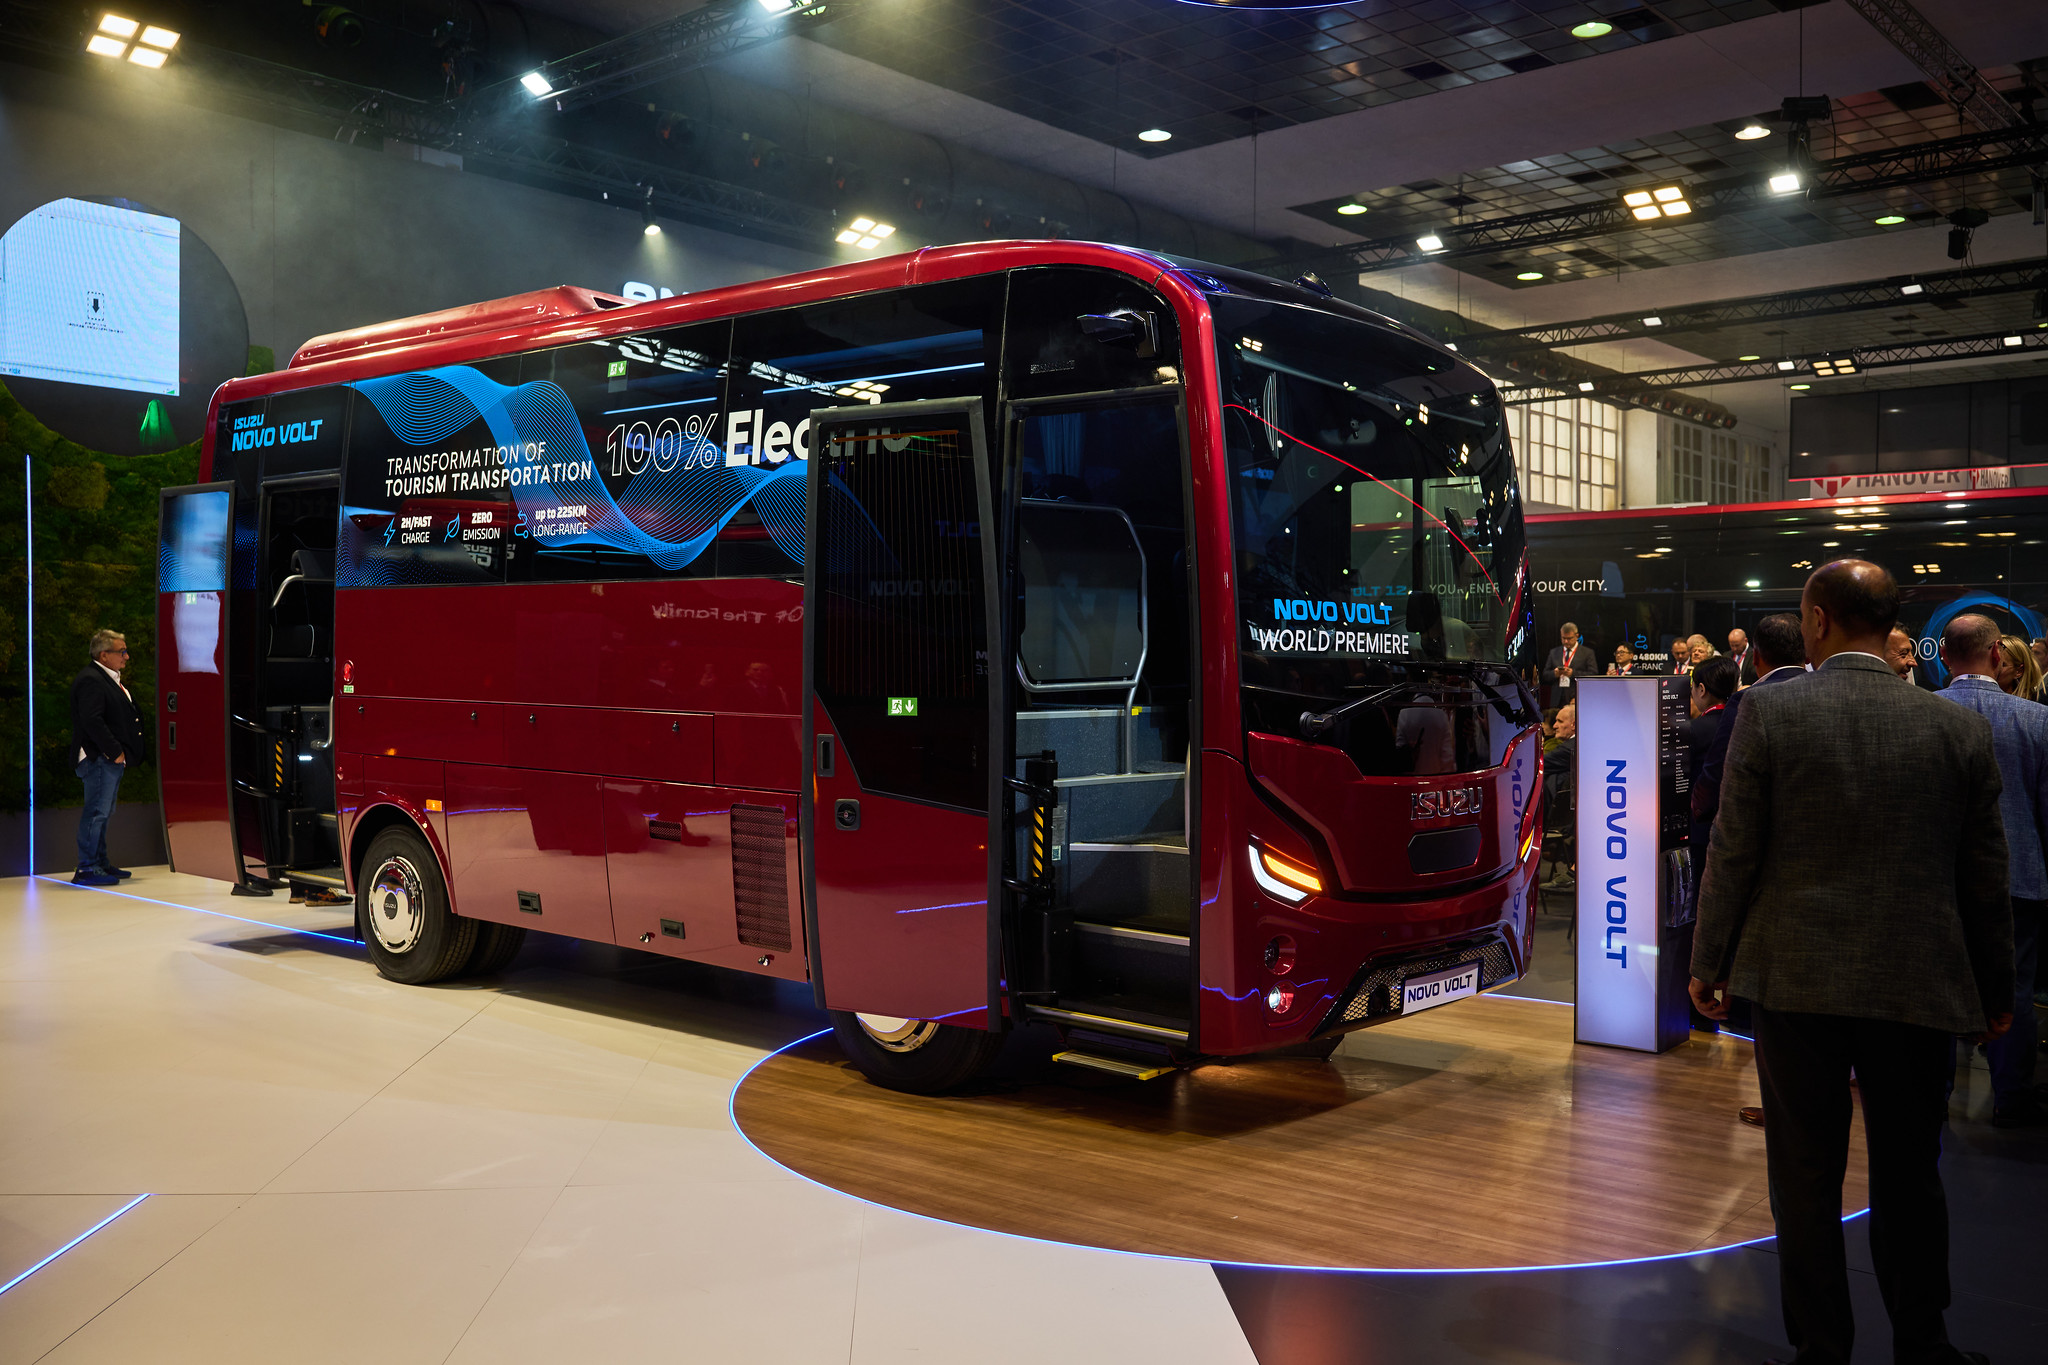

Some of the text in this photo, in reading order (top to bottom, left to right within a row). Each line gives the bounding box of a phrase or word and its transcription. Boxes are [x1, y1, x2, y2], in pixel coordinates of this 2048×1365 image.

[234, 413, 265, 431] ISUZU
[231, 418, 324, 452] NOVO VOLT
[606, 413, 719, 477] 100%
[387, 441, 546, 476] TRANSFORMATION OF
[385, 460, 592, 498] TOURISM TRANSPORTATION
[471, 511, 493, 525] ZERO
[535, 505, 587, 520] up to 225KM
[401, 515, 433, 531] 2H/FAST
[533, 521, 589, 538] LONG-RANGE
[401, 531, 430, 545] CHARGE
[462, 527, 501, 542] EMISSION
[1350, 585, 1381, 597] OLT
[1469, 582, 1501, 594] ENER
[1273, 598, 1393, 625] NOVO VOLT
[1258, 628, 1410, 655] WORLD PREMIERE
[1639, 653, 1668, 661] 480KM
[1410, 786, 1483, 821] ISUZU
[1606, 759, 1627, 969] NOVO VOLT
[1407, 974, 1473, 1003] NOVO VOLT
